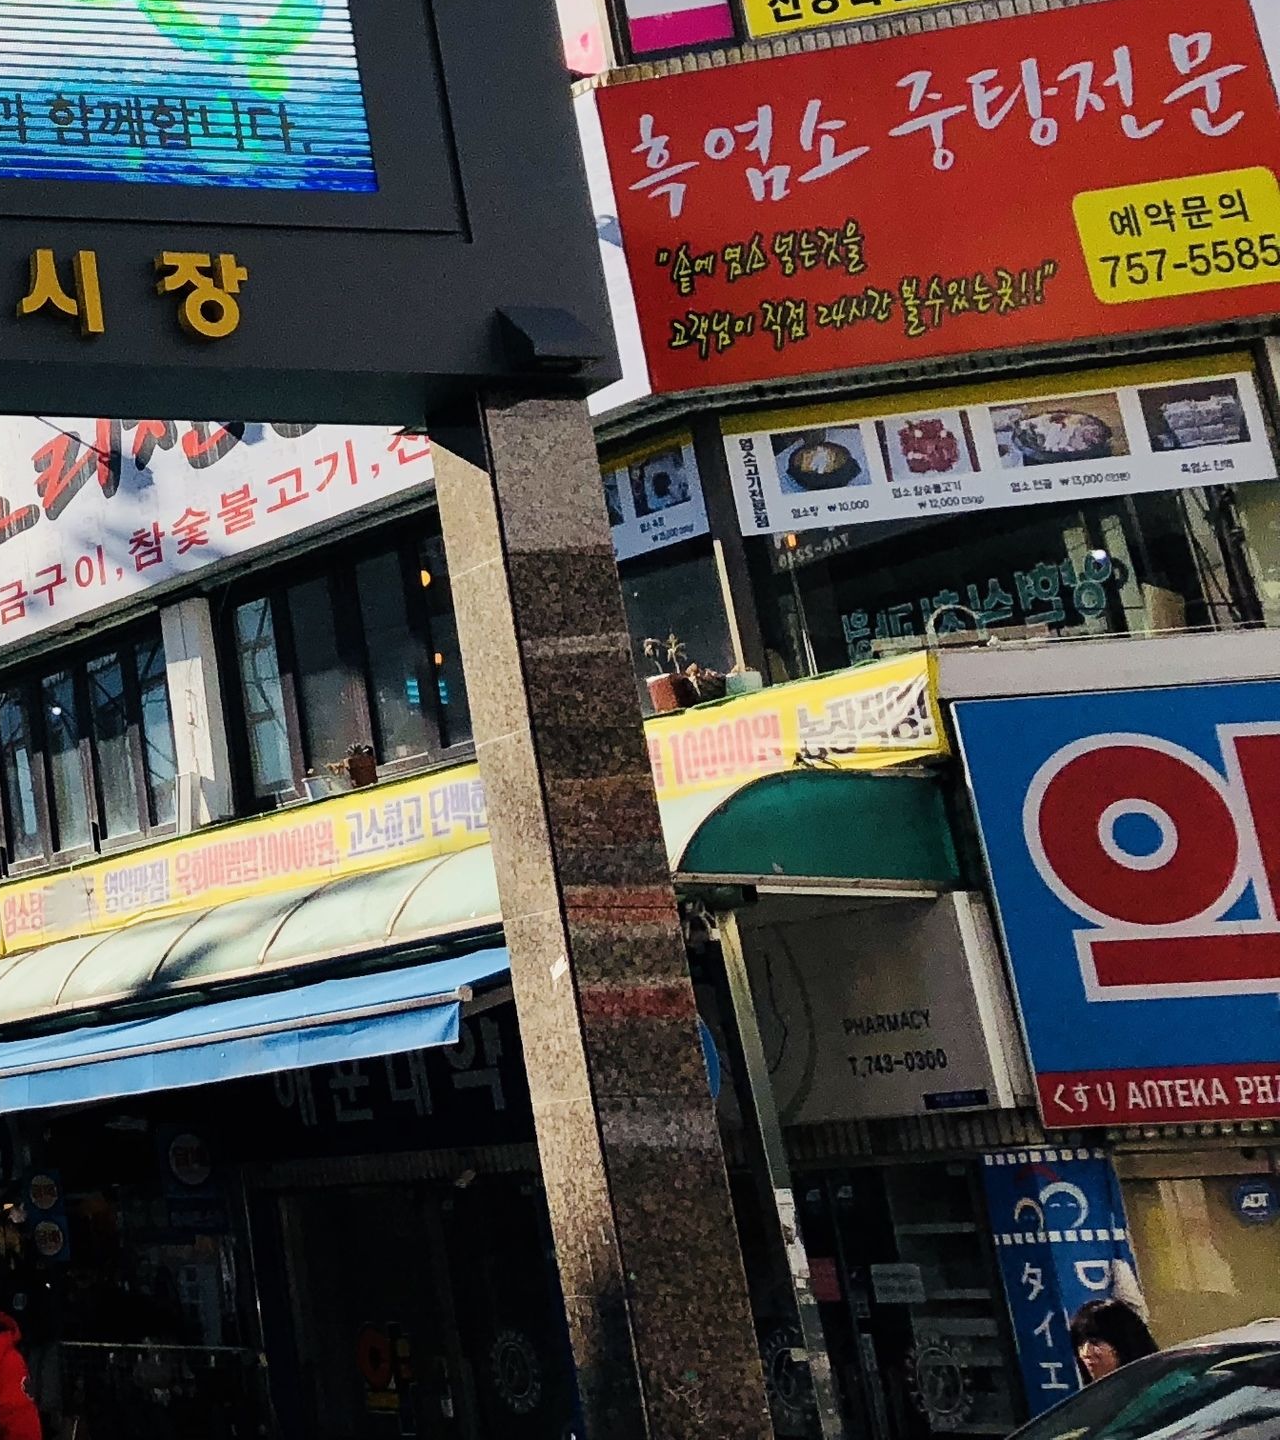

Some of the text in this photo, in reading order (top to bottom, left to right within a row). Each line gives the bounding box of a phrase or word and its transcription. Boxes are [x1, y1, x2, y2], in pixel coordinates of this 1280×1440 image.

[628, 30, 1248, 218] 흑염소 중탕전문
[1108, 187, 1253, 238] 예약문의
[723, 235, 768, 280] 염소
[1098, 232, 1280, 288] 757-5585
[669, 311, 754, 358] 고객님이
[761, 298, 809, 350] 직접
[815, 289, 895, 330] 24시간
[842, 1009, 930, 1036] PHARMACY
[1053, 1081, 1117, 1113] くすり
